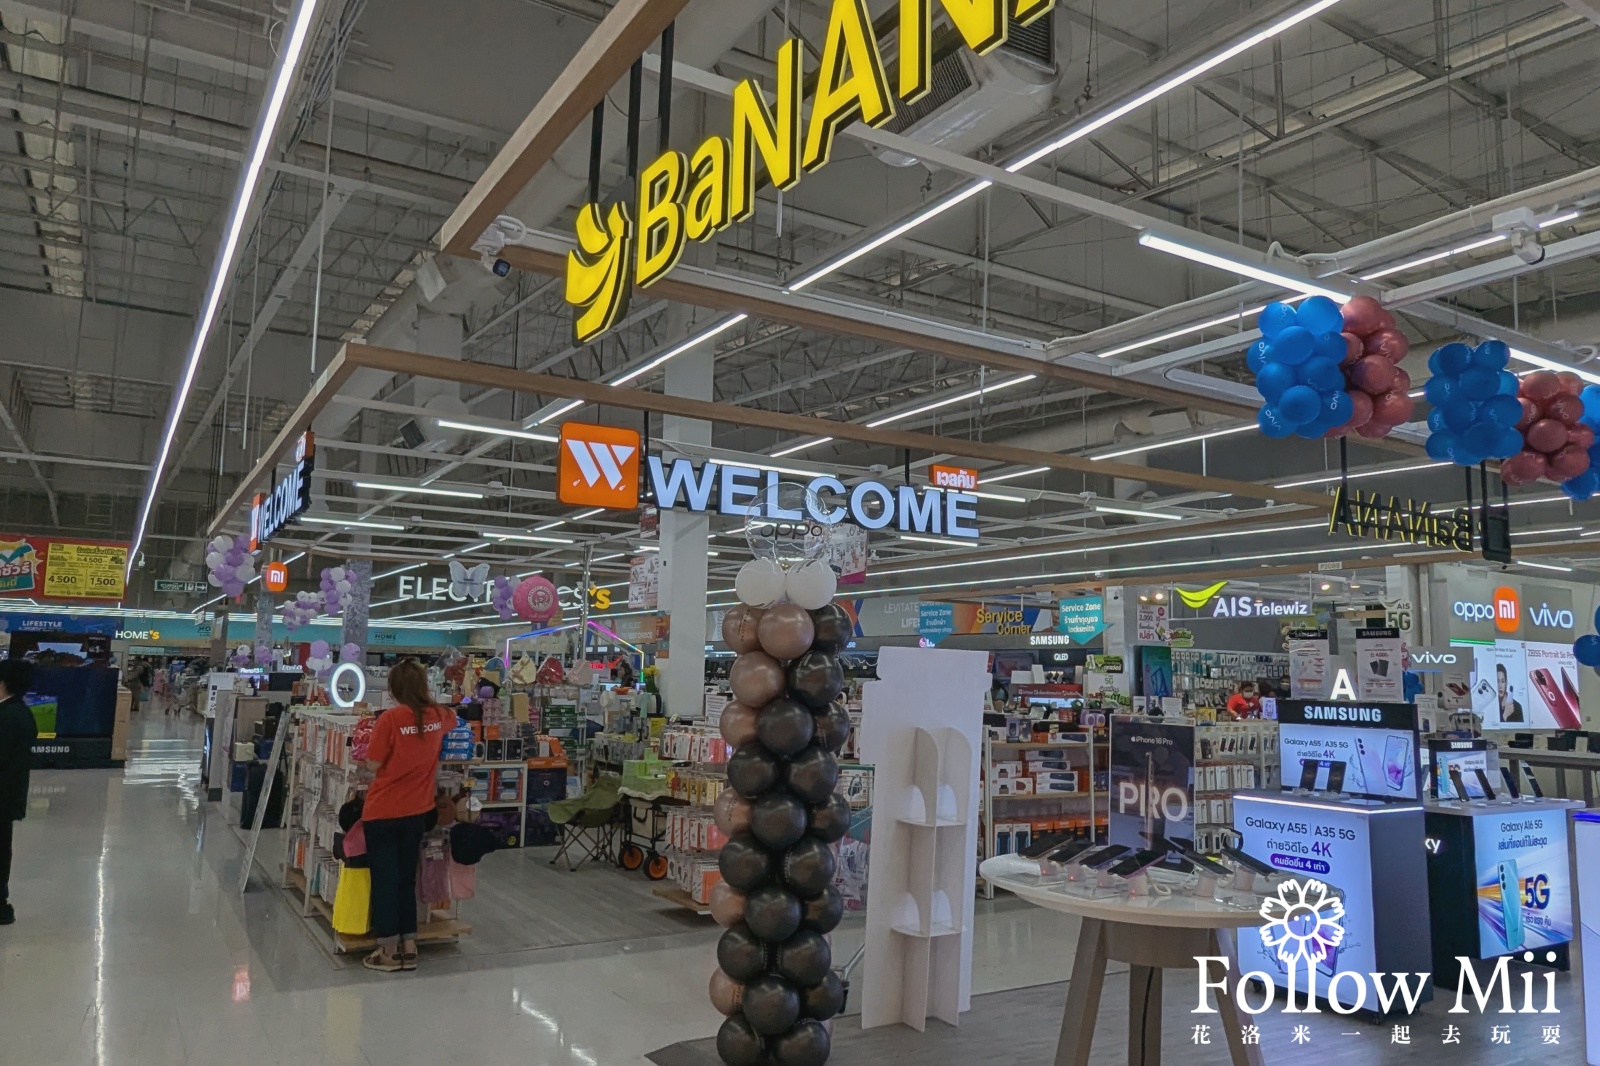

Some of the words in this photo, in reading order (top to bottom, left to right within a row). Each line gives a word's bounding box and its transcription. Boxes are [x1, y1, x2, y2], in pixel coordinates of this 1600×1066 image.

[936, 469, 976, 489] เวลคัม
[257, 460, 305, 544] WELCOME
[648, 455, 980, 538] WELCOME
[760, 523, 823, 540] oppo
[884, 602, 919, 614] LEVITATE
[921, 609, 939, 617] Service
[1061, 604, 1084, 613] Service
[1085, 603, 1101, 611] Zone
[1213, 596, 1252, 617] AIS
[1254, 601, 1308, 616] Telewiz
[1396, 602, 1411, 610] AIS
[1454, 601, 1495, 622] oppo
[976, 607, 1023, 624] Service
[1387, 611, 1411, 631] 5G
[1529, 603, 1574, 629] vivo
[22, 620, 63, 628] LIFESTYLE
[996, 623, 1032, 635] Corner
[1030, 635, 1070, 646] SAMSUNG
[1361, 629, 1393, 637] SAMSUNG
[1411, 651, 1457, 664] vivo
[1541, 649, 1560, 659] Portrait
[1330, 668, 1357, 701] A
[1304, 705, 1382, 722] SAMSUNG
[1135, 736, 1155, 744] iPhone
[1155, 737, 1162, 745] 16
[1163, 738, 1173, 746] Pro
[1284, 738, 1308, 748] Galaxy
[1324, 740, 1337, 748] A35
[1338, 741, 1349, 749] 5G
[1450, 741, 1473, 749] SAMSUNG
[1322, 749, 1336, 759] 4K
[1245, 816, 1286, 834] Galaxy
[1287, 822, 1308, 835] A55
[1314, 825, 1336, 838] A35
[1338, 829, 1356, 841] 5G
[1500, 821, 1524, 833] Galaxy
[1524, 820, 1534, 831] A16
[1534, 819, 1543, 829] 5G
[1266, 838, 1309, 854] ถ่ายวิดีโอ
[1311, 840, 1333, 858] 4K
[1274, 855, 1304, 868] คมชัดขึ้น
[1305, 860, 1312, 869] 4
[1313, 862, 1327, 872] เท่า
[1525, 873, 1551, 910] 5G
